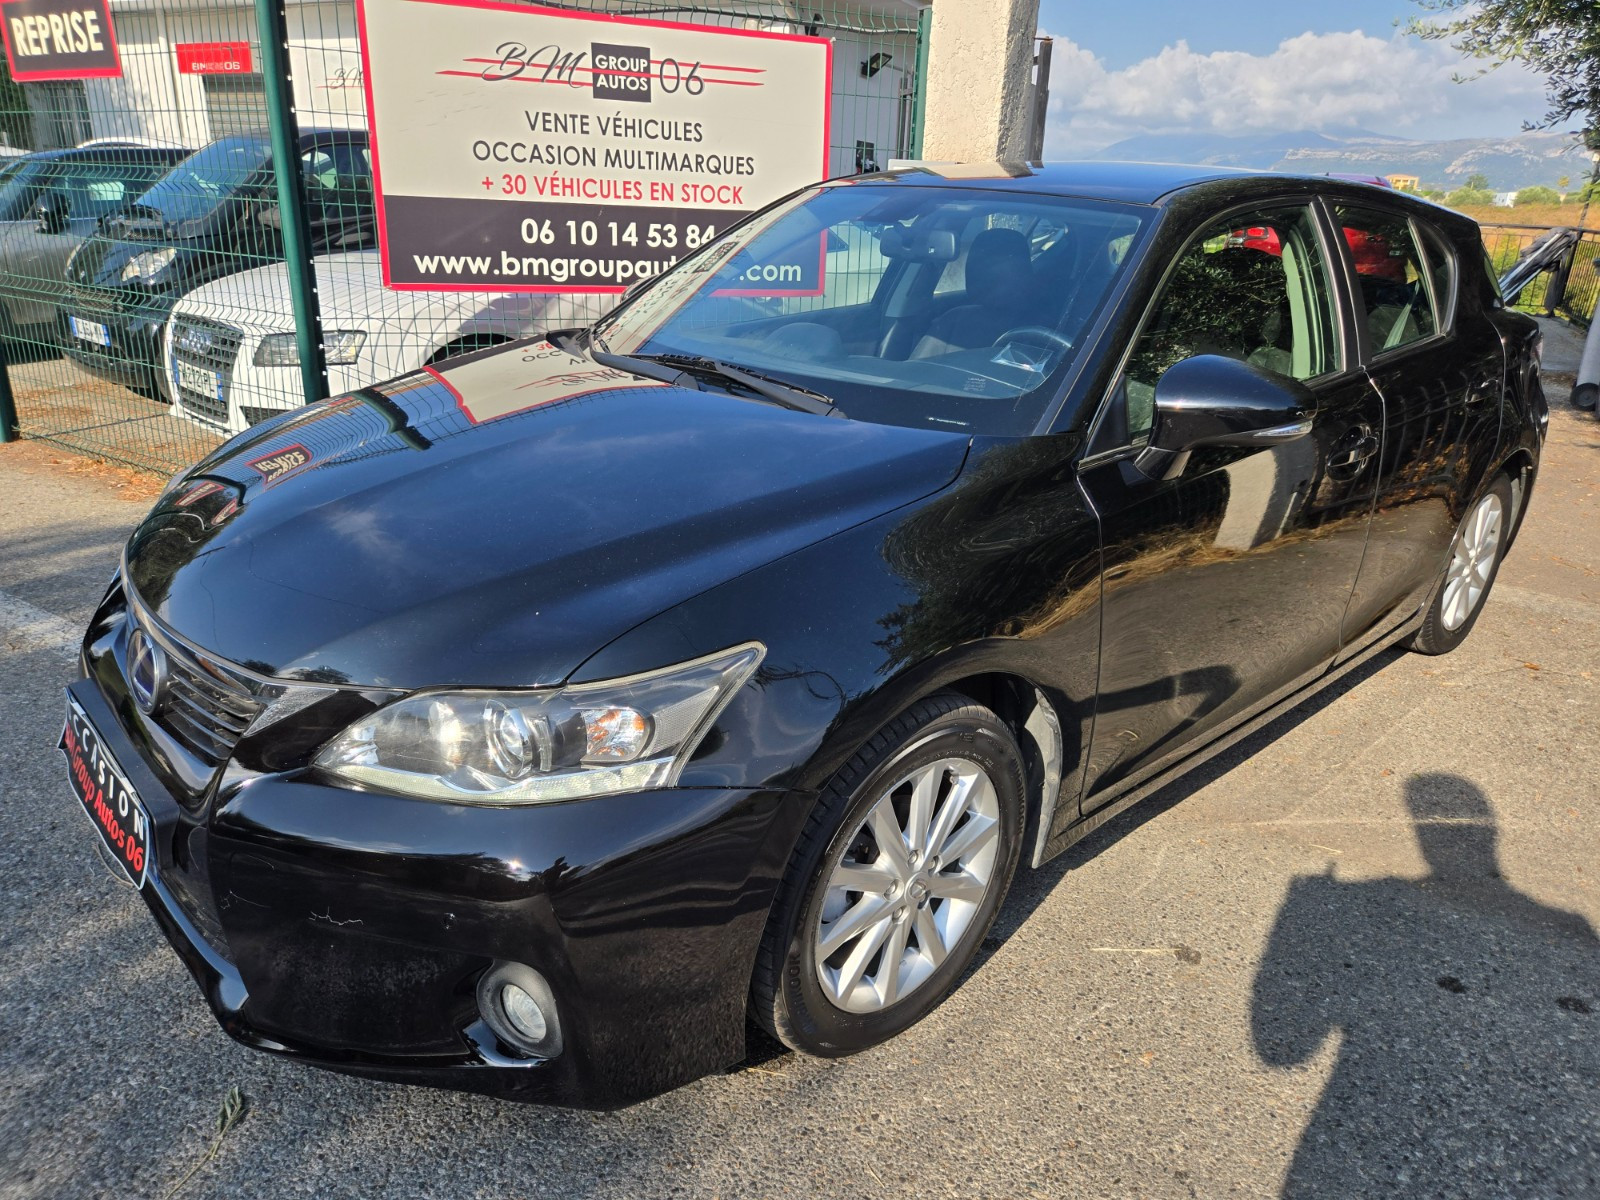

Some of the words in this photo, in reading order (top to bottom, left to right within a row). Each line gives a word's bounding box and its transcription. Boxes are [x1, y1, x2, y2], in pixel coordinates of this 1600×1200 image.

[10, 10, 104, 56] REPRISE
[481, 41, 587, 88] BM
[595, 55, 648, 72] GROUP
[659, 58, 704, 95] 06
[596, 74, 648, 91] AUTOS
[525, 110, 589, 134] VENTE
[597, 111, 703, 142] VÉHICULES
[473, 140, 595, 166] OCCASION
[604, 148, 755, 175] MULTIMARQUES
[482, 176, 494, 190] +
[502, 173, 528, 195] 30
[533, 170, 643, 200] VÉHICULES
[650, 182, 674, 201] EN
[681, 183, 743, 204] STOCK
[521, 218, 555, 244] 06
[566, 220, 598, 246] 10
[608, 222, 638, 247] 14
[646, 224, 677, 248] 53
[685, 225, 715, 249] 84
[73, 745, 95, 802] Group
[94, 789, 125, 848] Autos
[126, 836, 143, 871] 06
